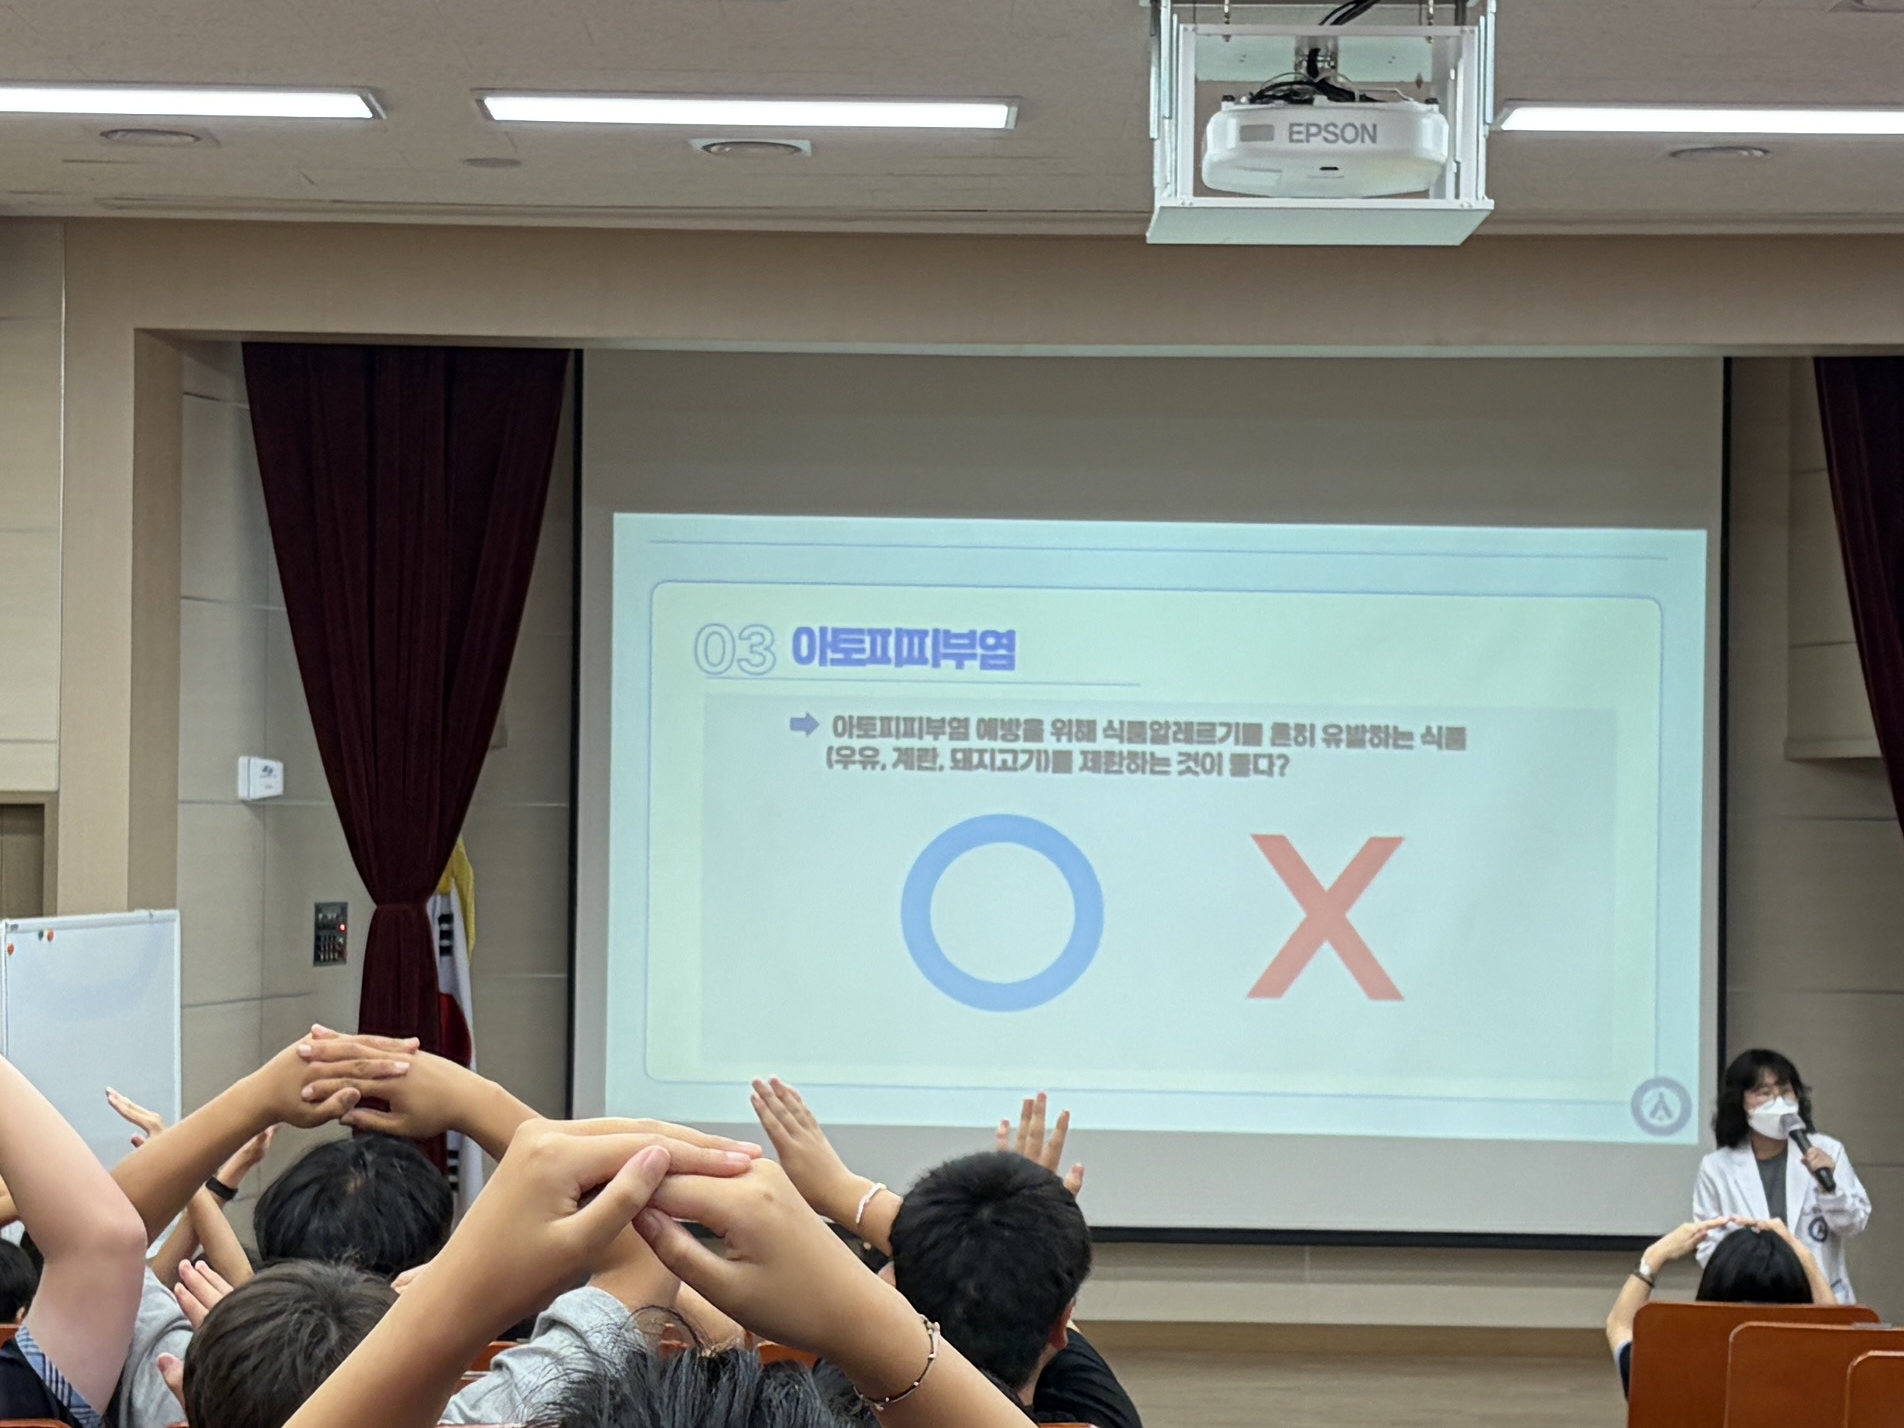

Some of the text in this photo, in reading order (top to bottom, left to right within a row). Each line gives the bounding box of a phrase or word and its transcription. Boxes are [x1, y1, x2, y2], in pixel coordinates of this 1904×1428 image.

[1287, 122, 1378, 145] EPSON
[693, 622, 1017, 676] 03 아토피피부염
[831, 714, 971, 742] 아토피피부염
[1049, 717, 1098, 744] 위해
[1321, 722, 1416, 750] 유발하는
[825, 744, 887, 771] (우유,
[891, 746, 946, 773] 계란,
[1078, 749, 1173, 776] 제한하는
[1176, 750, 1224, 777] 것이
